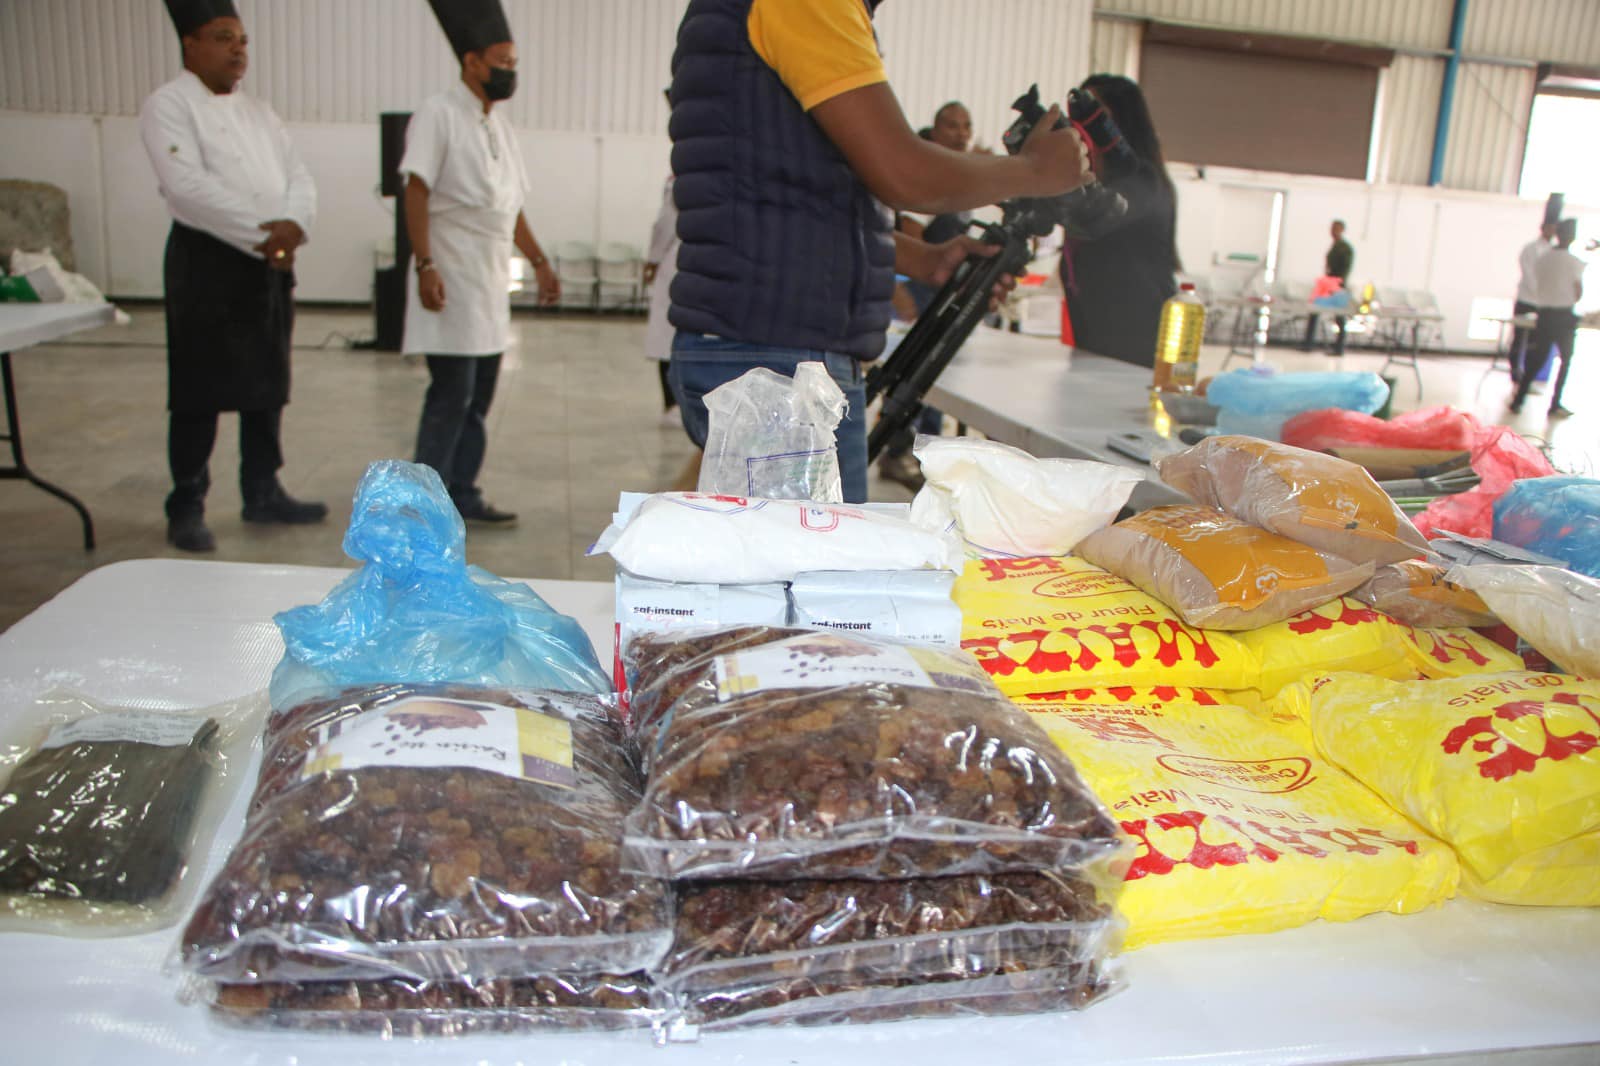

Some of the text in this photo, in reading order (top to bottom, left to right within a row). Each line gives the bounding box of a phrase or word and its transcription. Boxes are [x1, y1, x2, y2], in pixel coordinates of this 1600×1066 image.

[633, 606, 695, 617] saf-instant
[1052, 611, 1083, 622] de
[1091, 605, 1156, 618] Fleur
[1448, 680, 1526, 708] Maïs
[436, 743, 507, 761] Raisin
[1197, 793, 1234, 812] de
[1241, 803, 1318, 823] Fleur
